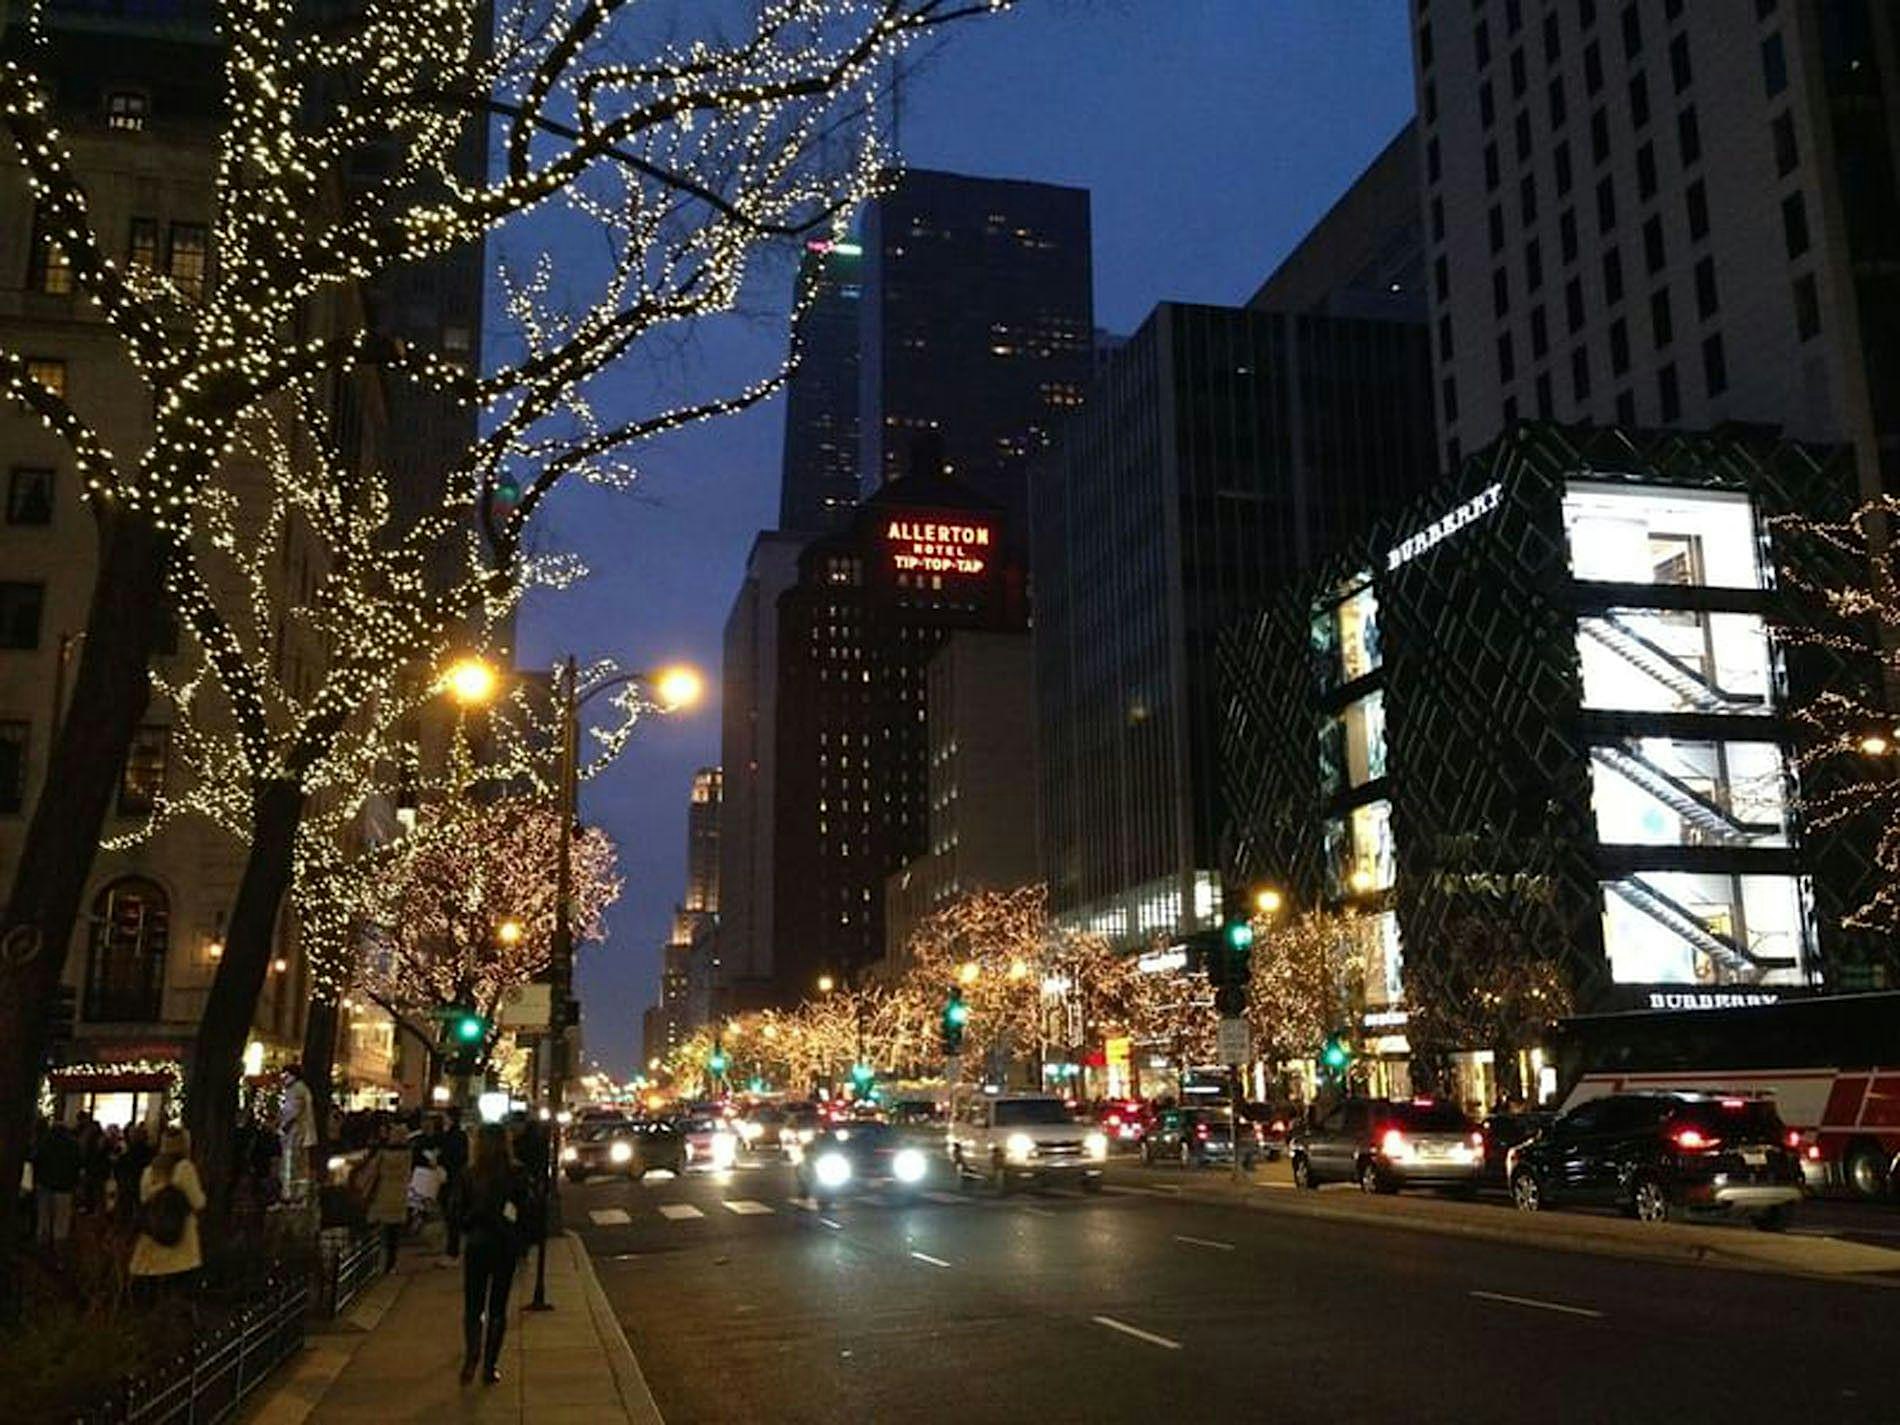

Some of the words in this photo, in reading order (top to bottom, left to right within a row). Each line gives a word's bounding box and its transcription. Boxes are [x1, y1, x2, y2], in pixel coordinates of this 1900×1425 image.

[888, 522, 989, 545] ALLERTON
[913, 543, 966, 557] HOTEL
[894, 555, 985, 573] TIP-TOP-TAP
[1649, 994, 1778, 1010] BURBERRY
